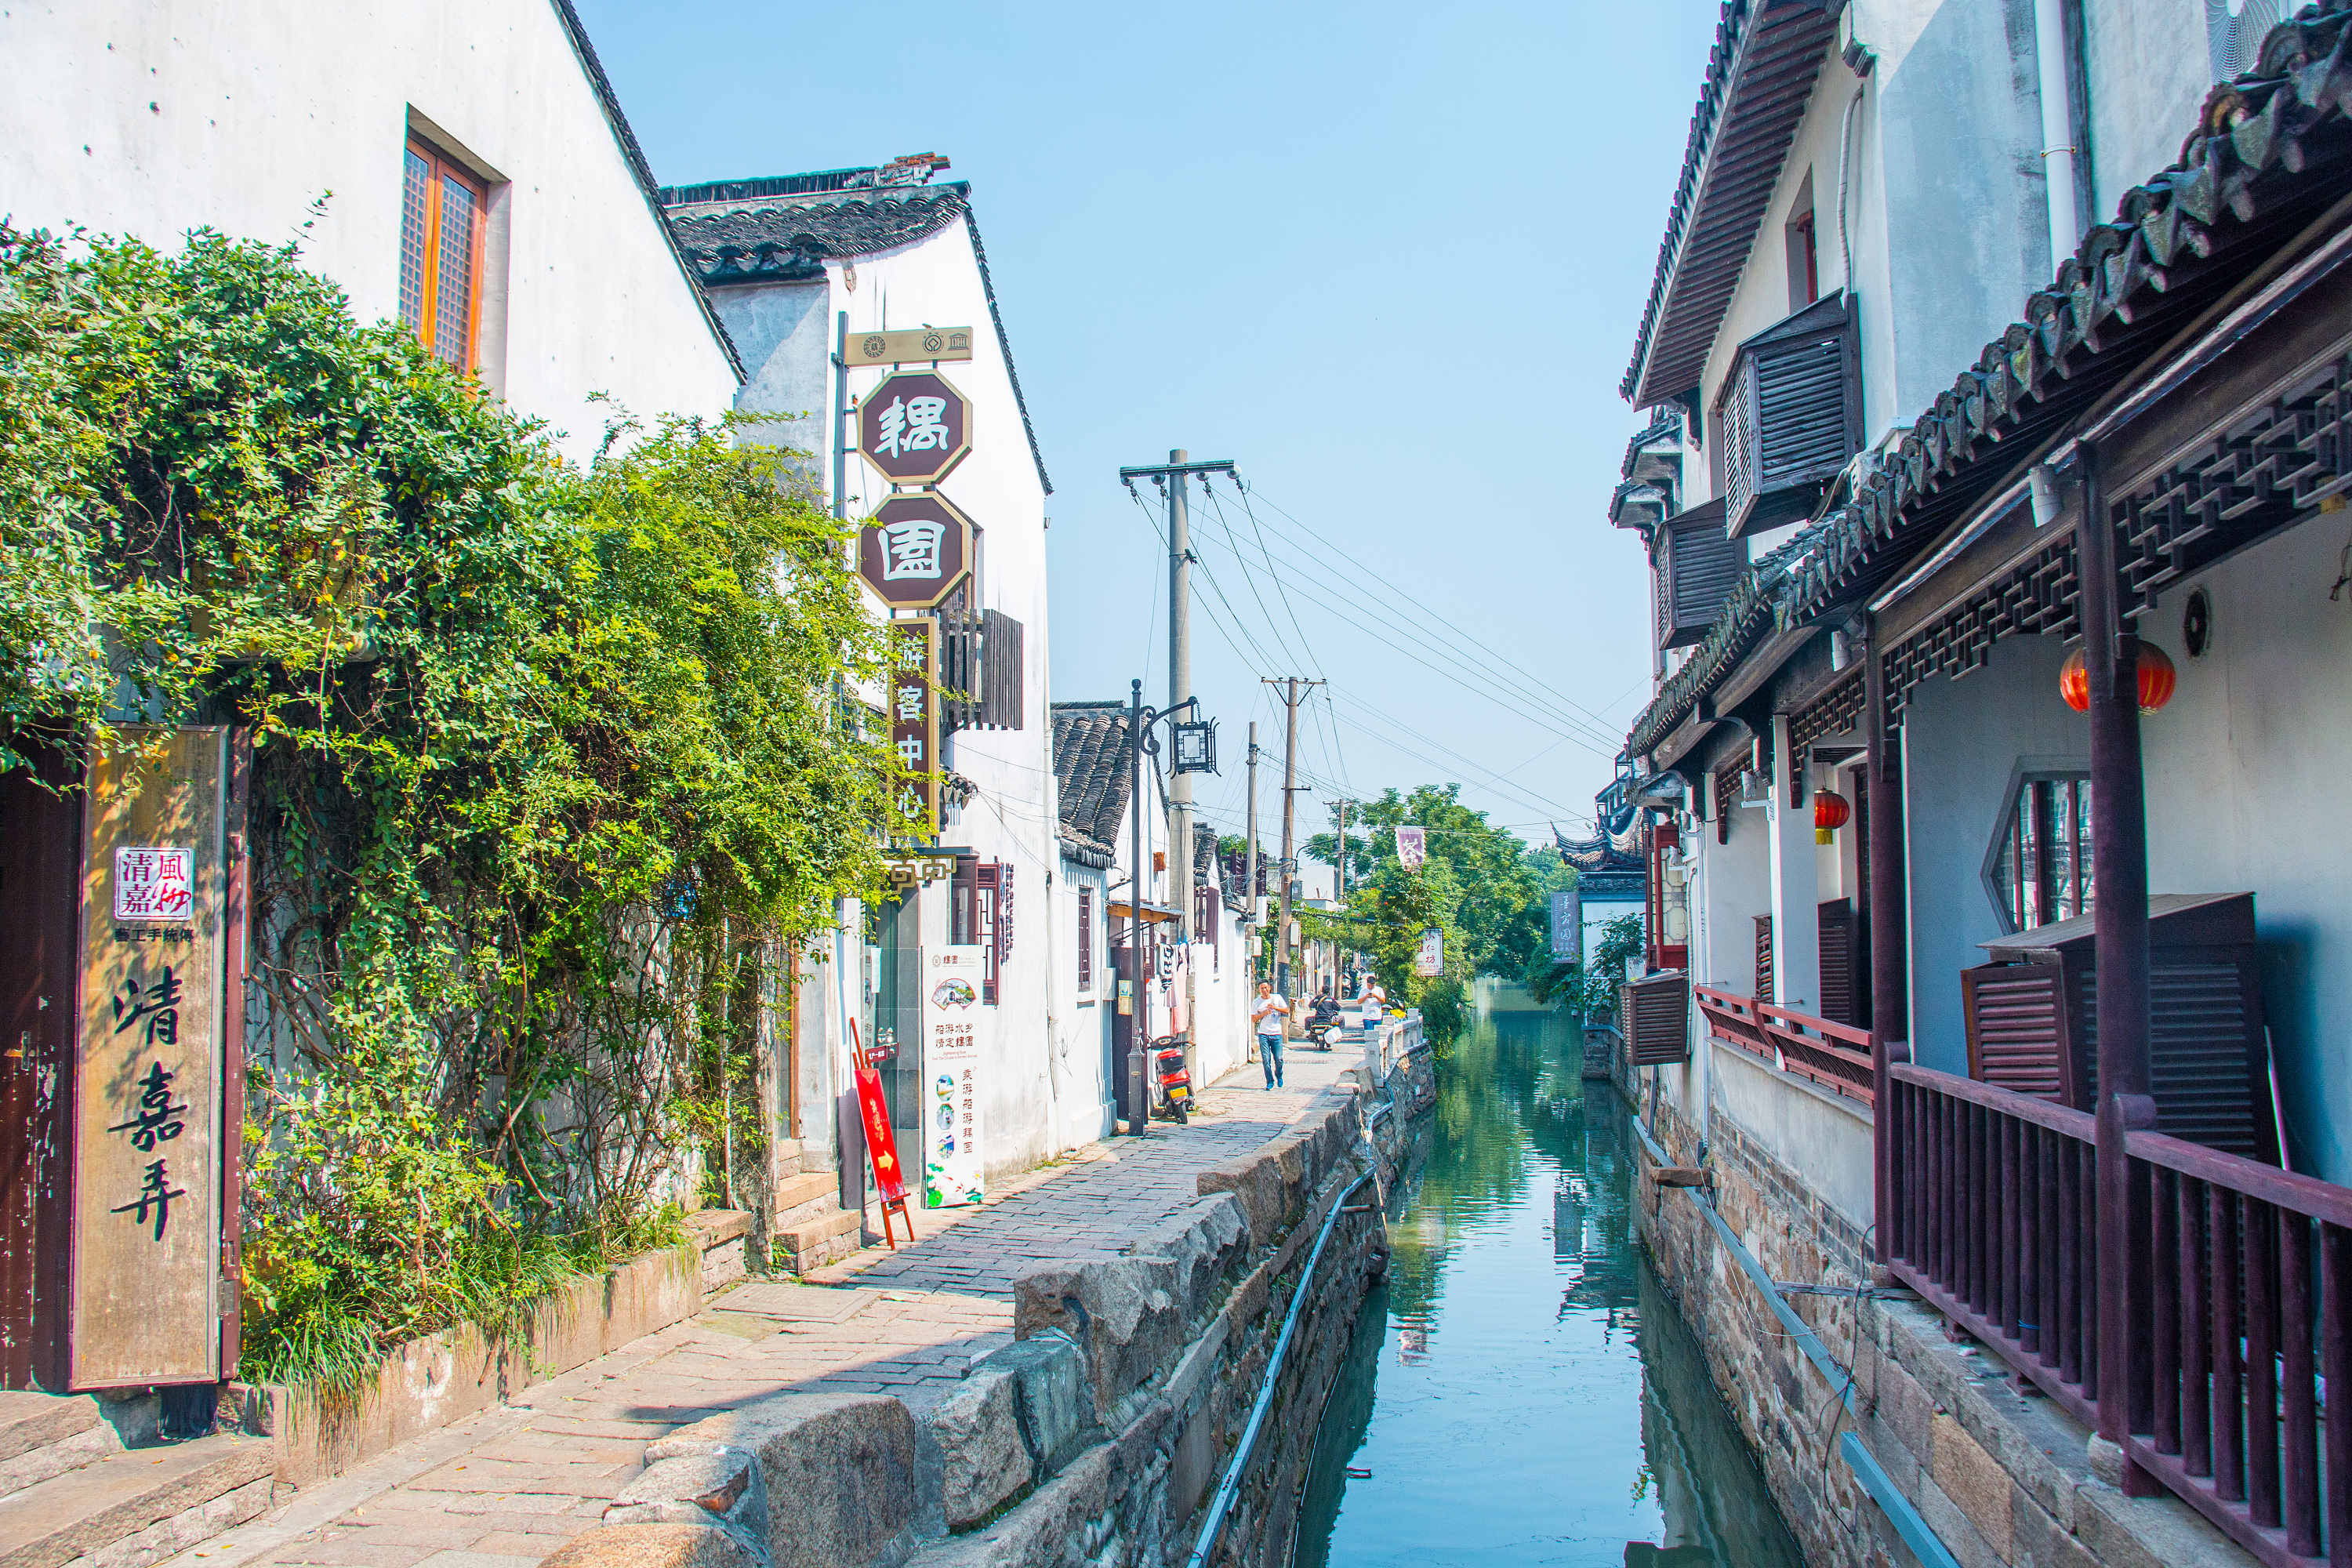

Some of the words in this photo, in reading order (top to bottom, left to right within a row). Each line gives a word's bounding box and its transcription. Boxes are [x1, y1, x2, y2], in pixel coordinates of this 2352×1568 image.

[1402, 838, 1423, 864] 茶
[935, 1023, 973, 1035] 船游水乡
[107, 965, 188, 1242] 清嘉弄
